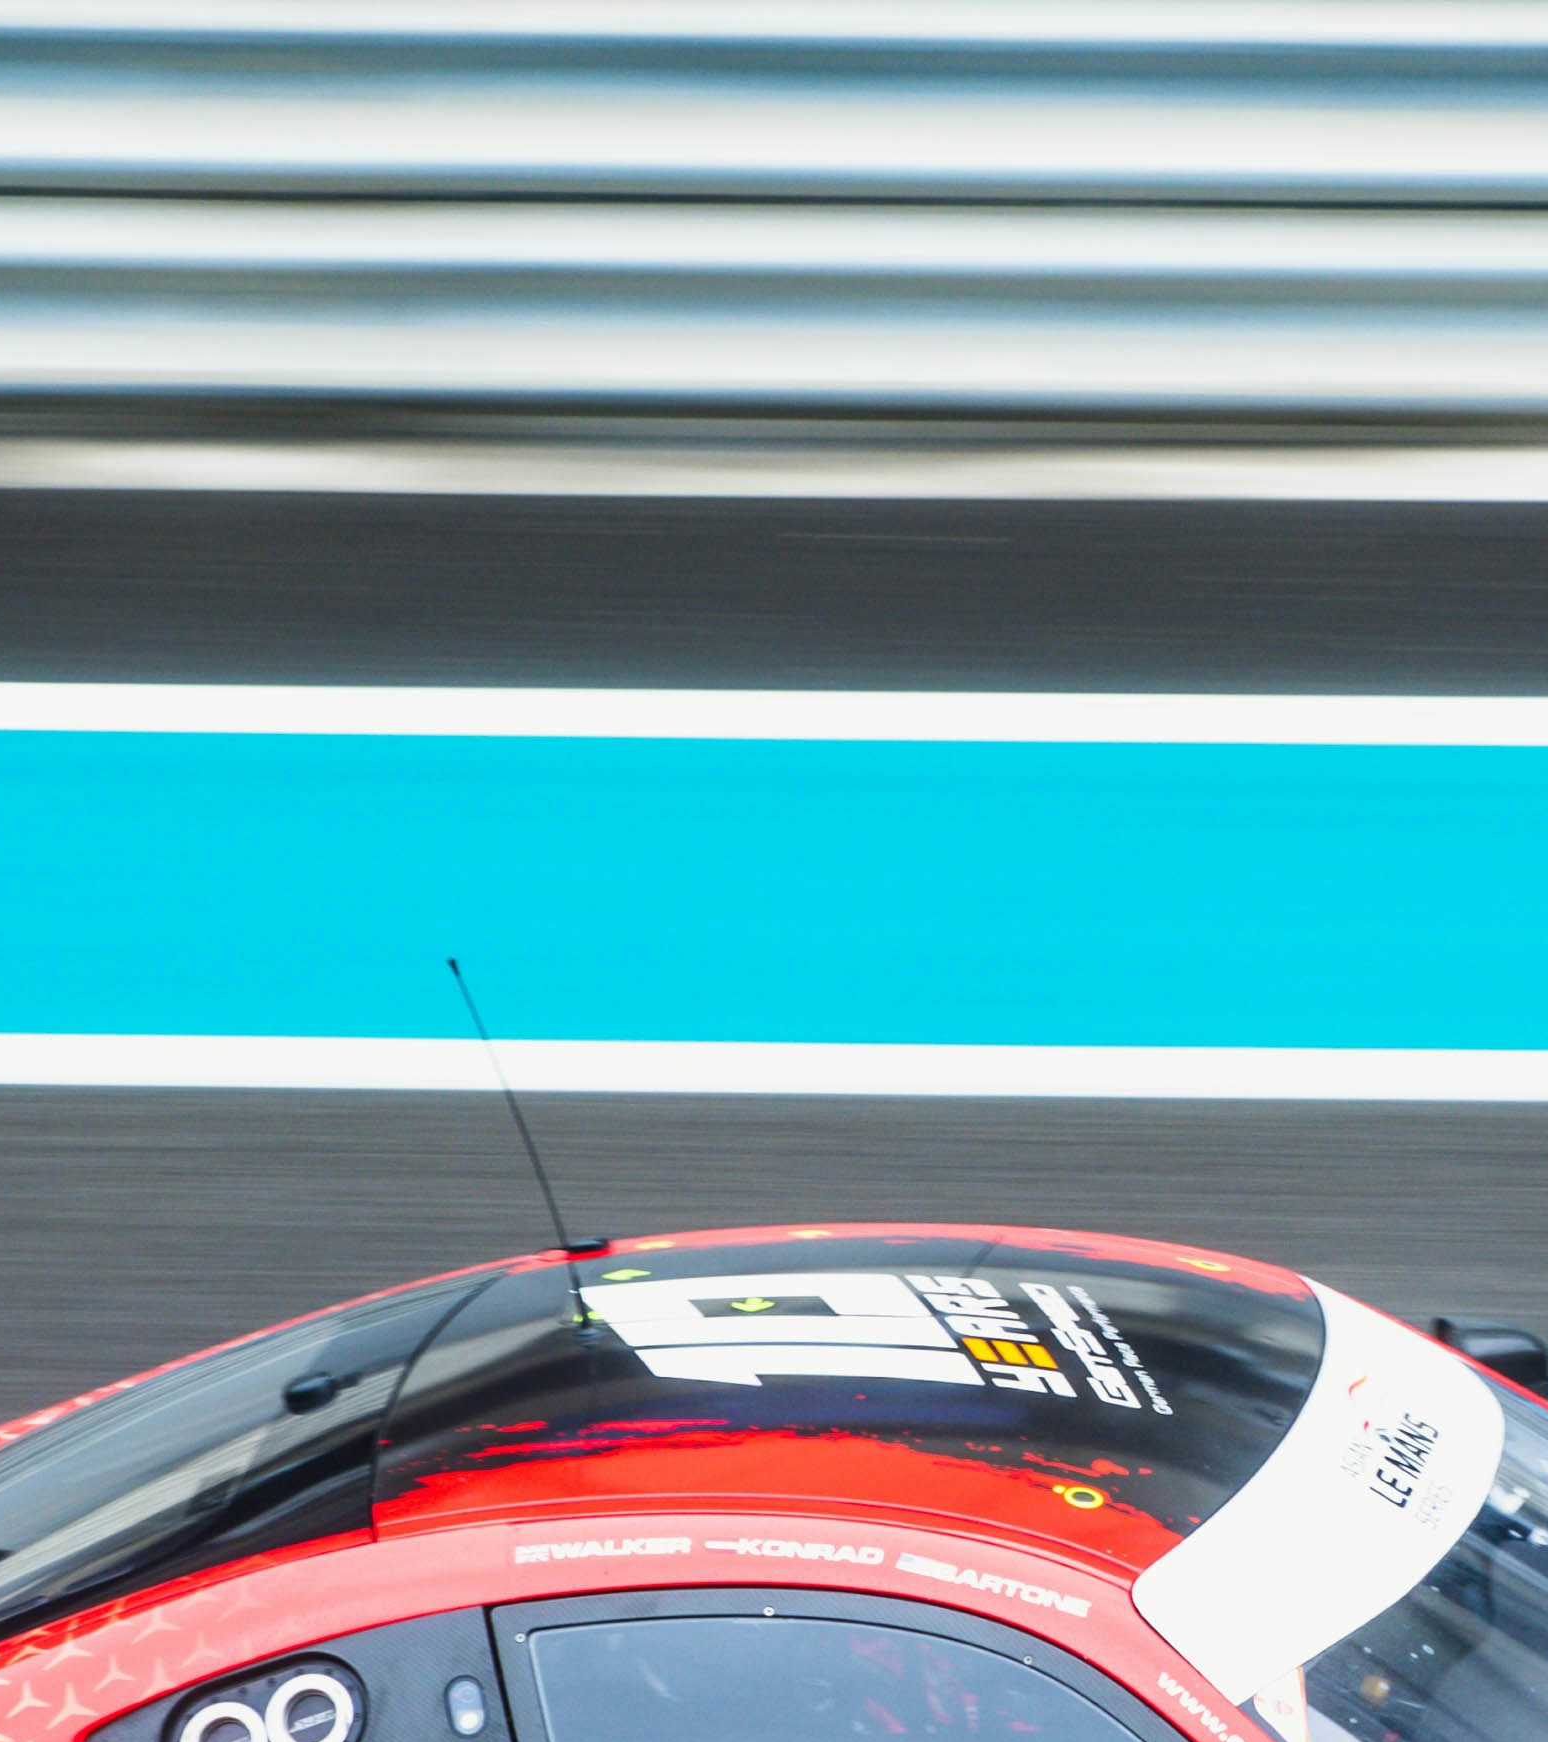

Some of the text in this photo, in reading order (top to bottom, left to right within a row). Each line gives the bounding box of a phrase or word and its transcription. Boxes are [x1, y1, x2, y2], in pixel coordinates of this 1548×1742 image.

[580, 1273, 987, 1388] 10
[1369, 1412, 1439, 1508] LE MANS
[550, 1537, 1093, 1619] WALKER KONRAD BARTONE
